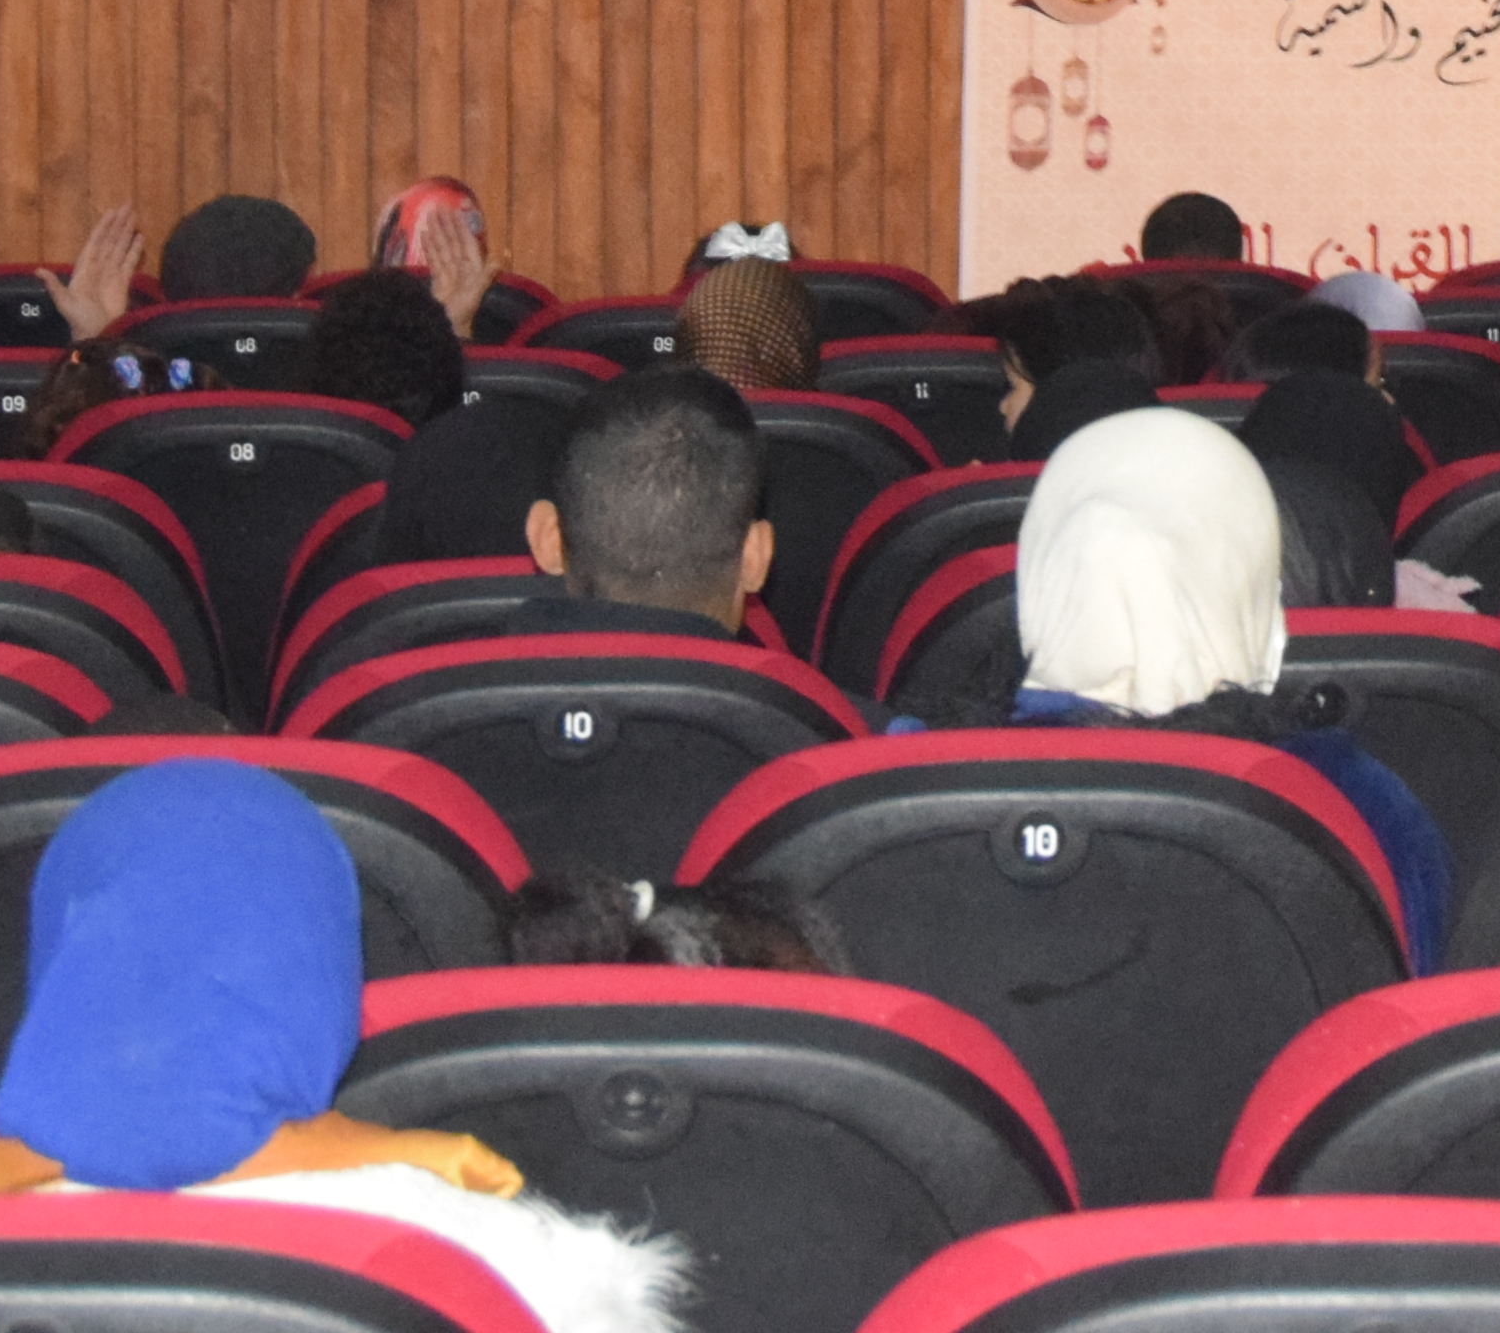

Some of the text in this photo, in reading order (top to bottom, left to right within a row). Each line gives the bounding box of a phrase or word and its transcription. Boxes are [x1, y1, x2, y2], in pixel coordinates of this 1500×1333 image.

[235, 336, 257, 354] 08
[654, 335, 675, 353] 09
[2, 394, 26, 414] 09
[230, 442, 255, 462] 08
[563, 711, 594, 741] 10
[1022, 823, 1060, 859] 10
